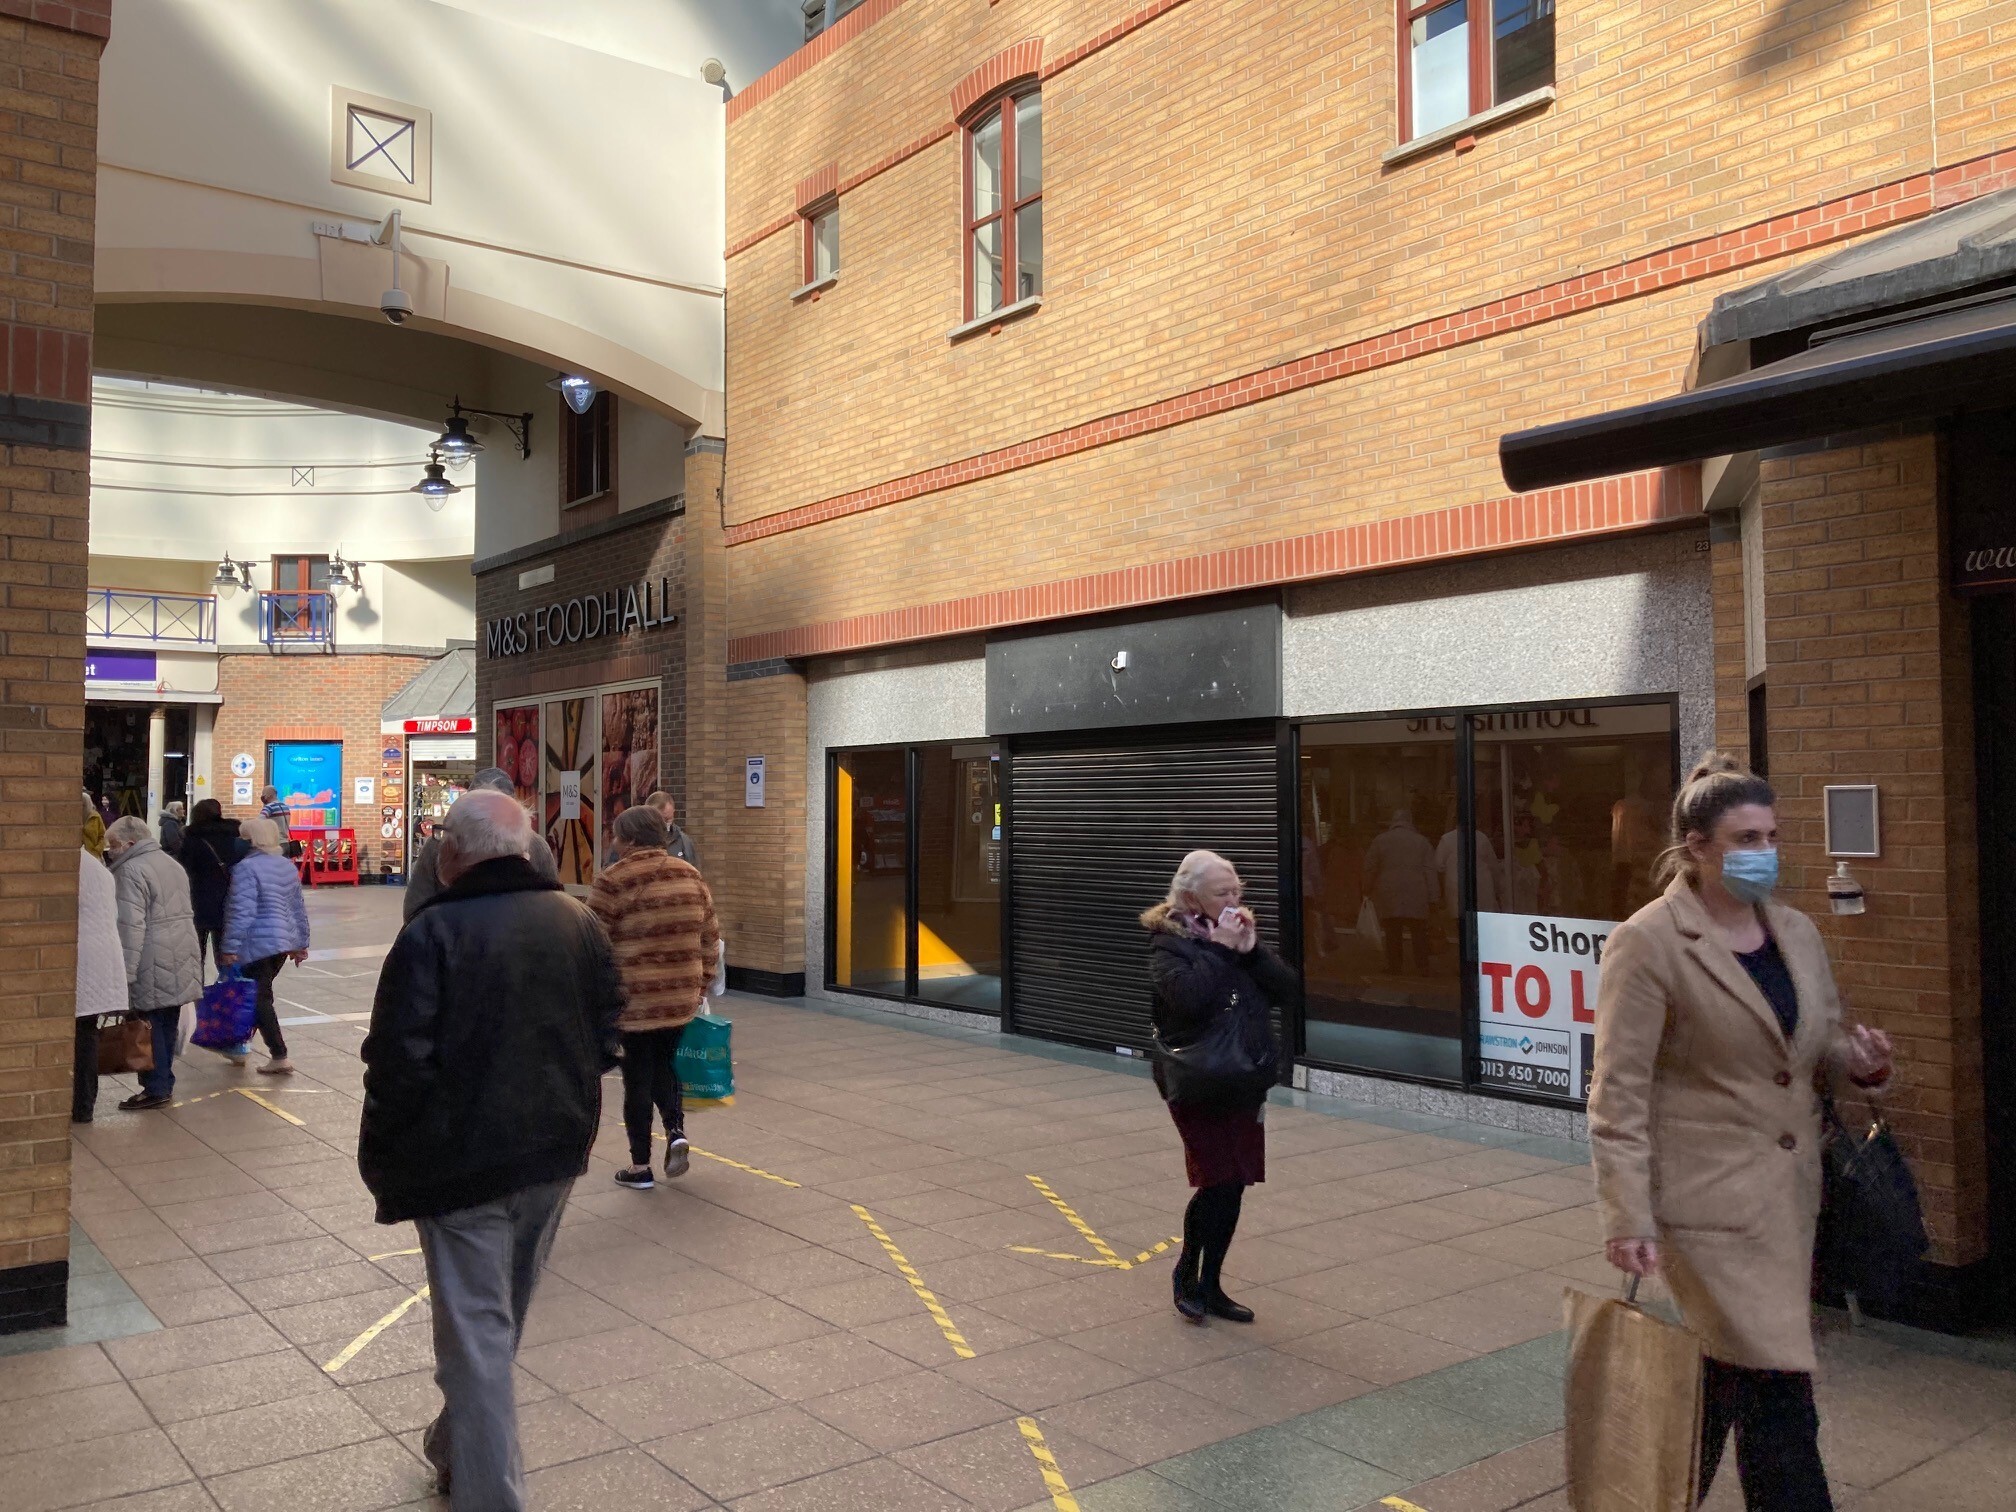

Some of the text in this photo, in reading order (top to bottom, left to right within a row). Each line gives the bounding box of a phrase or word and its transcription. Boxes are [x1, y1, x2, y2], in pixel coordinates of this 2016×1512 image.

[1697, 541, 1709, 551] 23
[486, 577, 676, 659] M&S FOODHALL
[416, 720, 459, 732] TIMPSON
[562, 784, 578, 798] M&S
[1528, 921, 1608, 965] Shop
[1481, 961, 1552, 1019] TO
[1535, 1041, 1568, 1055] JOHNSON
[1508, 1065, 1533, 1082] 450
[1536, 1068, 1569, 1087] 7000
